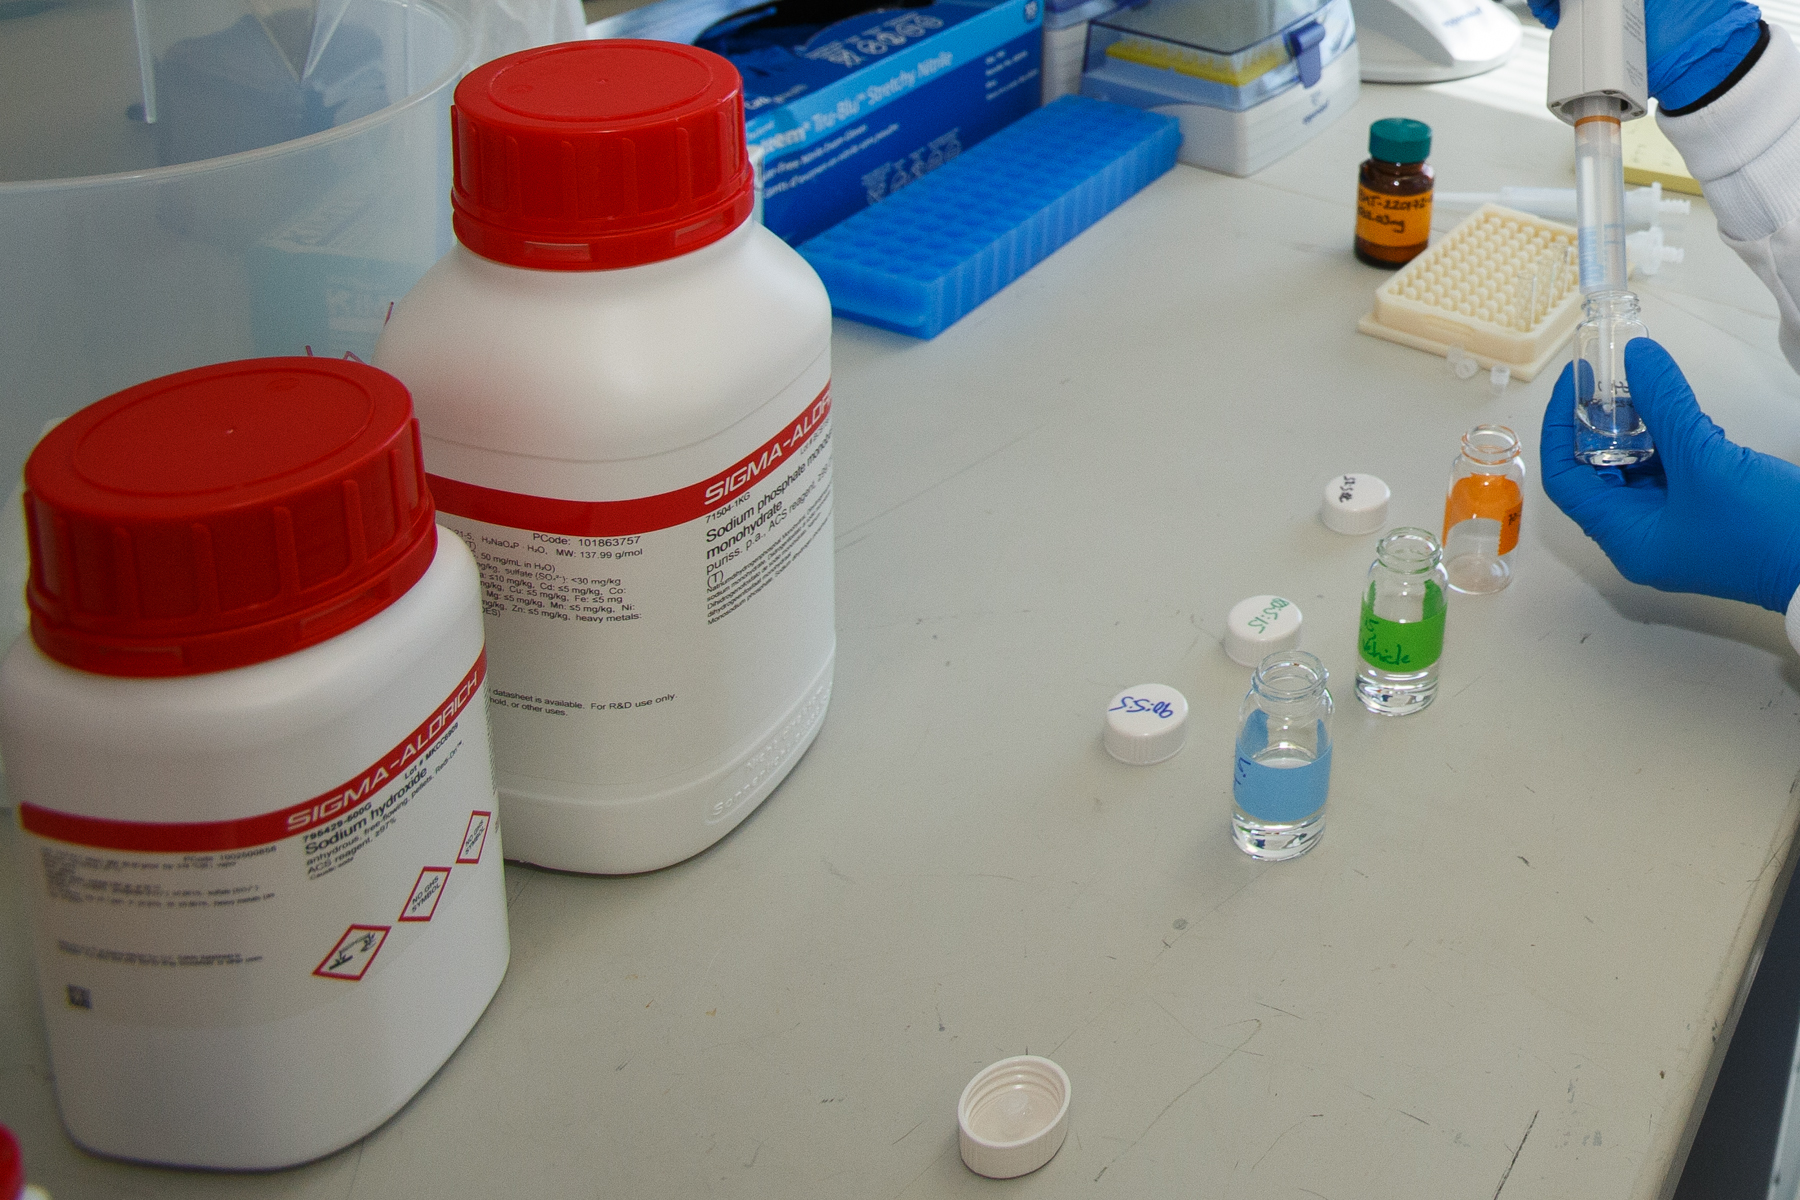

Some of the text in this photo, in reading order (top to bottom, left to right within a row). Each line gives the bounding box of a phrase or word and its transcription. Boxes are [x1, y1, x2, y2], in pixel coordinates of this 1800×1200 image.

[706, 506, 755, 543] Sodium
[757, 463, 806, 514] phosphate
[706, 492, 751, 523] 71504-1KG
[448, 527, 474, 541] 21-5,
[556, 548, 577, 558] MW:
[580, 551, 613, 560] 137.99
[615, 549, 643, 560] g/mol
[532, 532, 641, 548] PCode: 101863757
[706, 501, 783, 560] monohydrate
[706, 547, 743, 575] puriss.
[768, 508, 788, 532] ACS
[505, 567, 533, 578] sulfate
[590, 577, 621, 587] mg/kg
[608, 586, 627, 595] Co:
[707, 570, 724, 589] (T)
[575, 614, 603, 624] heavy
[606, 612, 643, 622] metals:
[492, 688, 678, 711] datasheet is available. For R&D use only.
[521, 700, 543, 714] other
[545, 707, 568, 717] uses.
[287, 670, 478, 832] SIGMA-ALDRICH
[404, 764, 418, 780] Lot
[302, 801, 373, 843] 795429-500G
[305, 767, 428, 856] Sodium hydroxide
[306, 835, 361, 867] anhydrous,
[307, 859, 332, 875] ACS
[334, 837, 372, 864] reagent,
[411, 875, 439, 905] NO GHS
[411, 883, 441, 913] SYMBOL
